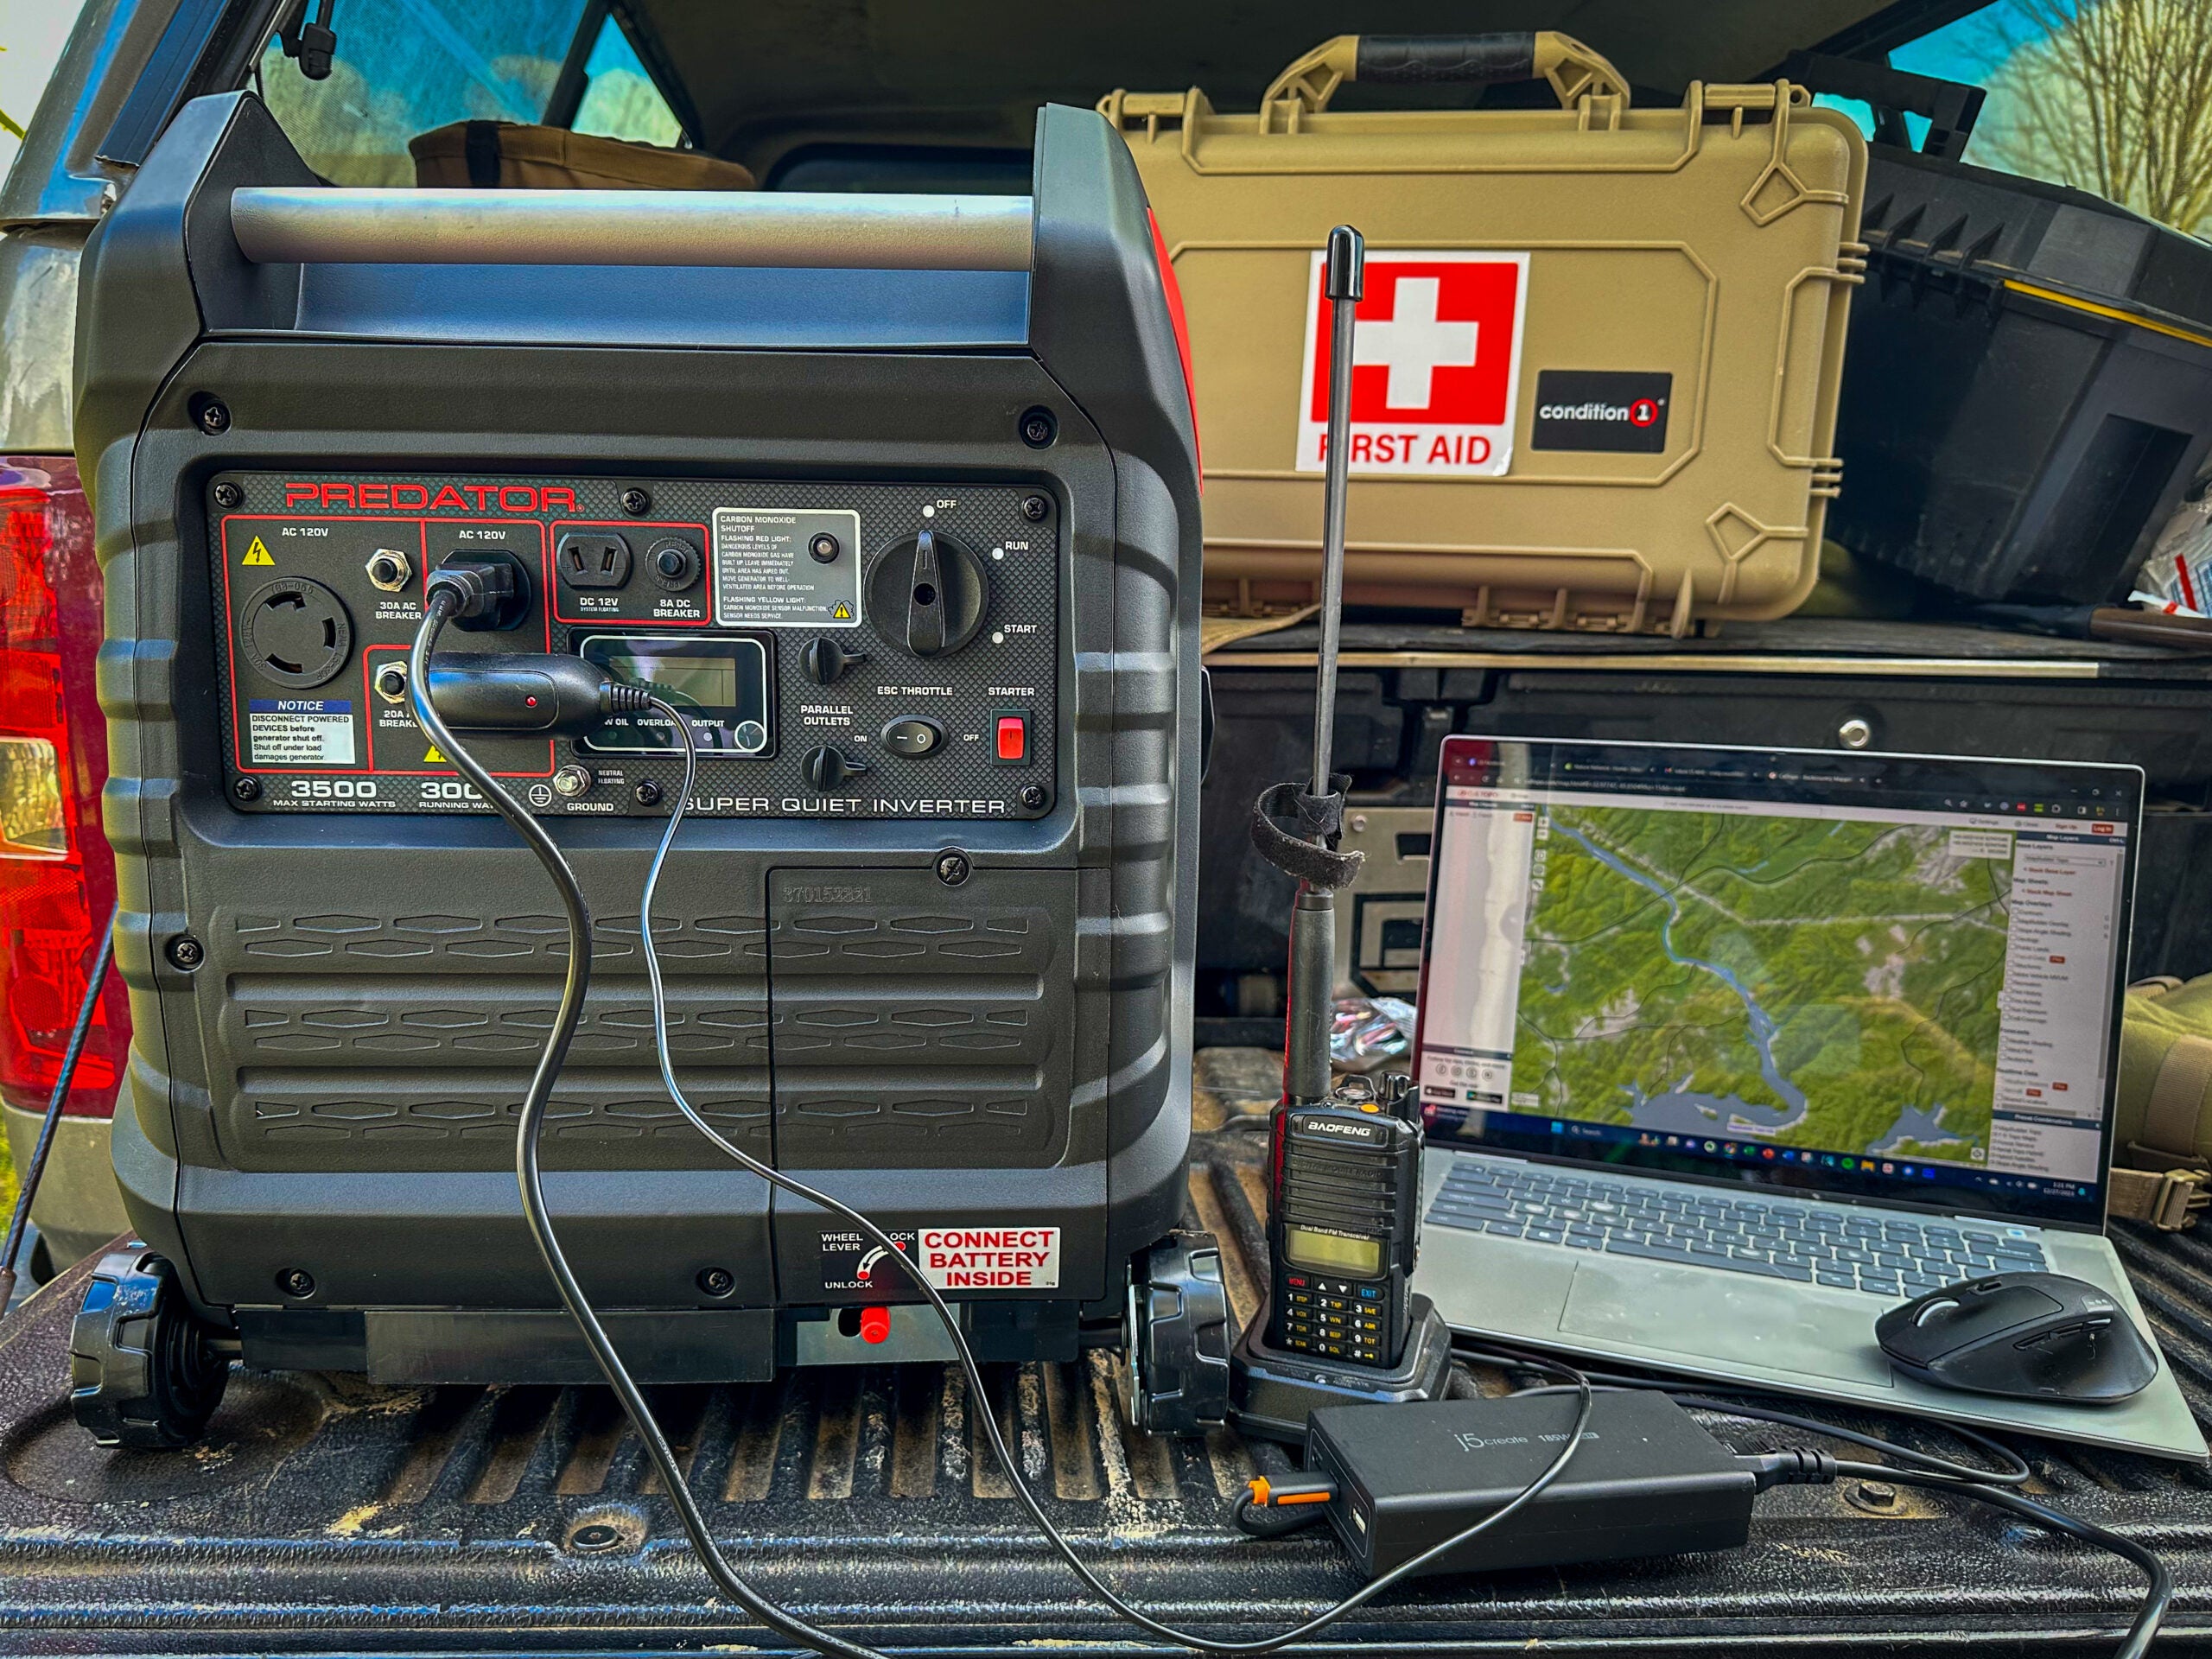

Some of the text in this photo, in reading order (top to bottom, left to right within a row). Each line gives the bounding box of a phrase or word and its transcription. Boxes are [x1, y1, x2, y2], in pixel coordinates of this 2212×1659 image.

[1319, 433, 1491, 465] FRST AID
[286, 483, 576, 512] PREDATOR
[936, 499, 957, 509] OFF
[282, 527, 328, 537] AC 120V
[459, 531, 506, 540] AC 120V
[1005, 540, 1029, 550] RUN
[379, 601, 401, 611] 30A
[403, 601, 416, 611] AC
[580, 597, 619, 606] DC 12V
[660, 599, 691, 608] 8A DC
[375, 610, 423, 620] BREAKER
[653, 608, 701, 618] BREAKER
[1003, 624, 1037, 634] START
[877, 686, 953, 696] ESC THROTTLE
[988, 687, 1035, 696] STARTER
[277, 701, 324, 711] NOTICE
[800, 705, 854, 715] PARALLEL
[803, 716, 851, 727] OUTLETS
[854, 734, 868, 743] ON
[963, 734, 979, 742] OFF
[290, 780, 377, 798] 3500
[566, 803, 614, 812] GROUND
[685, 797, 1007, 815] SUPER QUIET INVERTER
[1308, 1122, 1371, 1136] BAOFENG
[822, 1232, 864, 1242] WHEEL
[884, 1232, 915, 1241] OCK
[924, 1231, 1054, 1249] CONNECT
[1338, 1230, 1370, 1241] Transceiver
[822, 1243, 861, 1251] LEVER
[930, 1251, 1050, 1268] BATTERY
[946, 1271, 1032, 1286] INSIDE
[824, 1280, 874, 1289] UNLOCK
[1287, 1293, 1294, 1301] 1
[1361, 1288, 1376, 1298] EXIT
[1320, 1299, 1342, 1309] 2 TXP
[1356, 1305, 1376, 1315] 3 SAVE
[1320, 1313, 1326, 1322] 5
[1287, 1322, 1293, 1331] 7
[1355, 1319, 1362, 1328] 6
[1319, 1328, 1325, 1337] 8
[1354, 1334, 1376, 1345] 9 TOT
[1453, 1433, 1529, 1452] j5create
